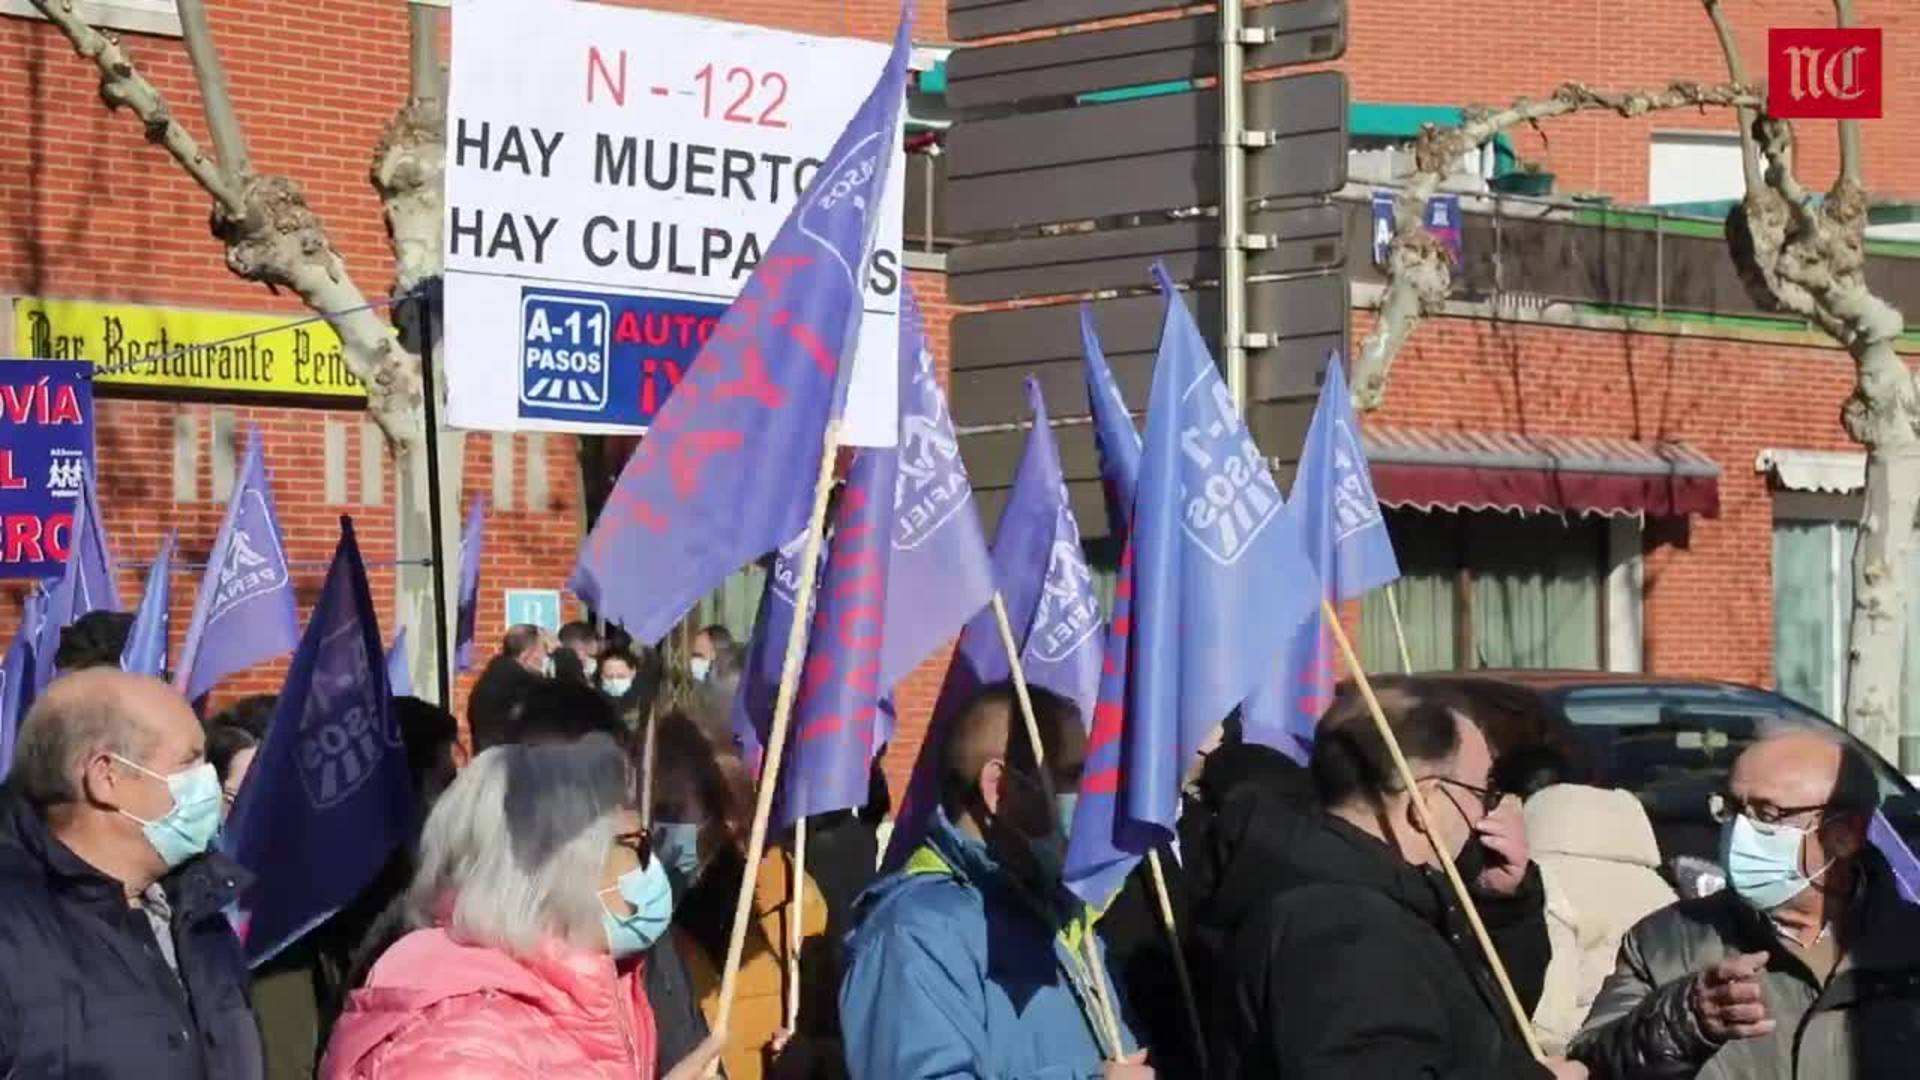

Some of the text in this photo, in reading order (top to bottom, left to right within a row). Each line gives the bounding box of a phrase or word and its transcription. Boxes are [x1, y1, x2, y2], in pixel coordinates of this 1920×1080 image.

[586, 47, 627, 107] N
[694, 63, 789, 129] 122
[456, 118, 564, 178] HAY
[450, 207, 559, 264] HAY
[28, 310, 85, 360] Bar
[97, 315, 274, 382] Restaurante
[527, 308, 603, 346] A-11
[527, 347, 601, 374] PASOS
[0, 375, 84, 425] VÍA
[0, 513, 77, 564] RO
